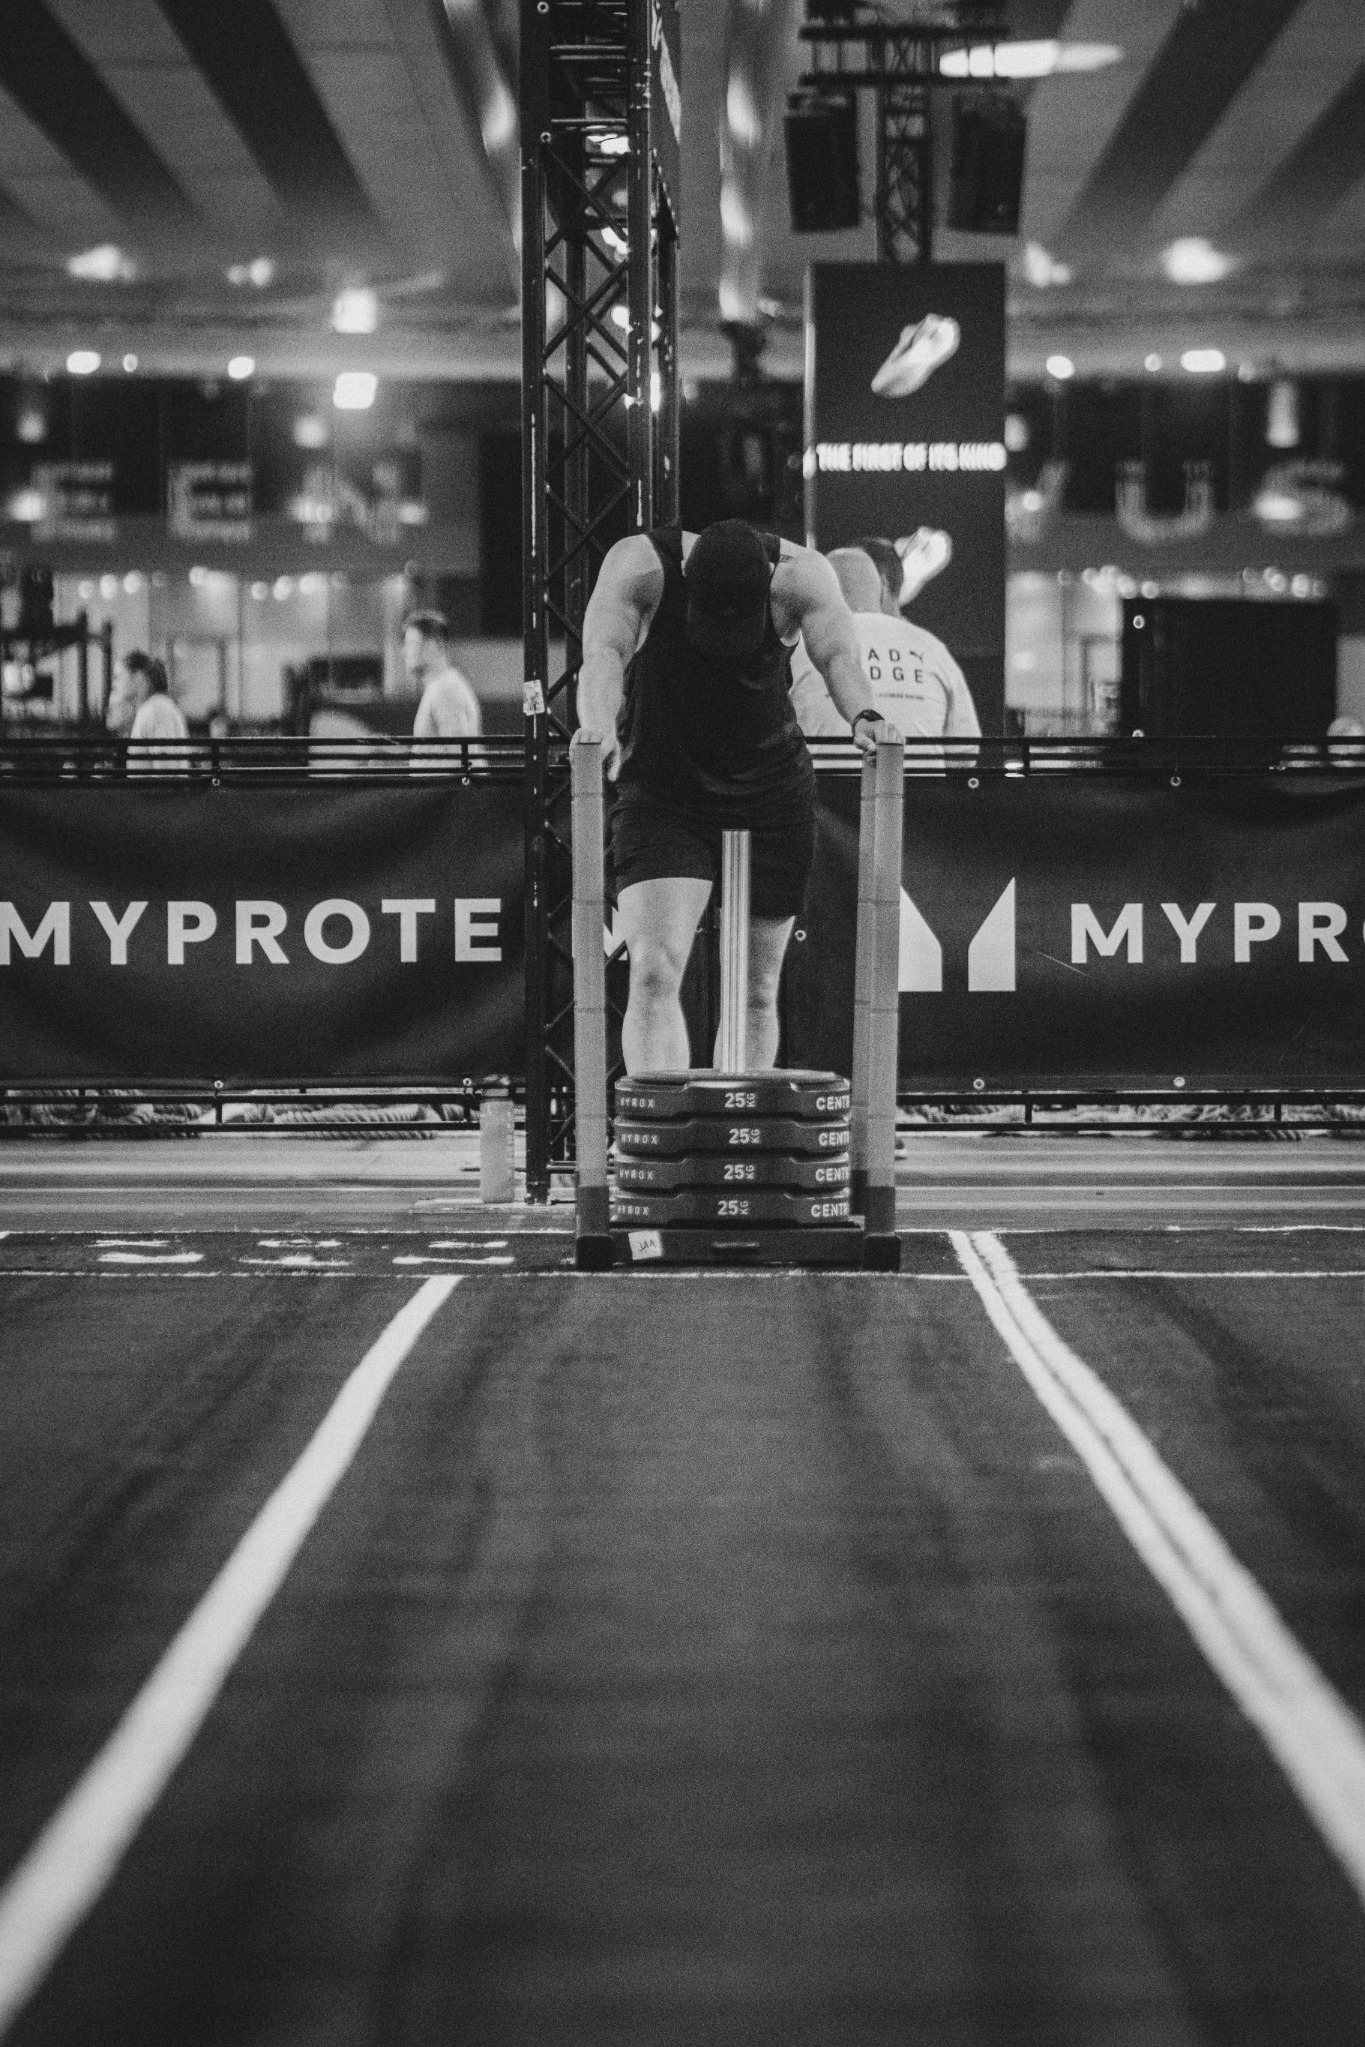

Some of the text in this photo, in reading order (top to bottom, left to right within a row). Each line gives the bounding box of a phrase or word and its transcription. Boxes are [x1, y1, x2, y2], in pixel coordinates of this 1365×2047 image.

[869, 666, 923, 684] DGE
[0, 898, 628, 966] MYPROTE
[1071, 901, 1365, 964] MYPR
